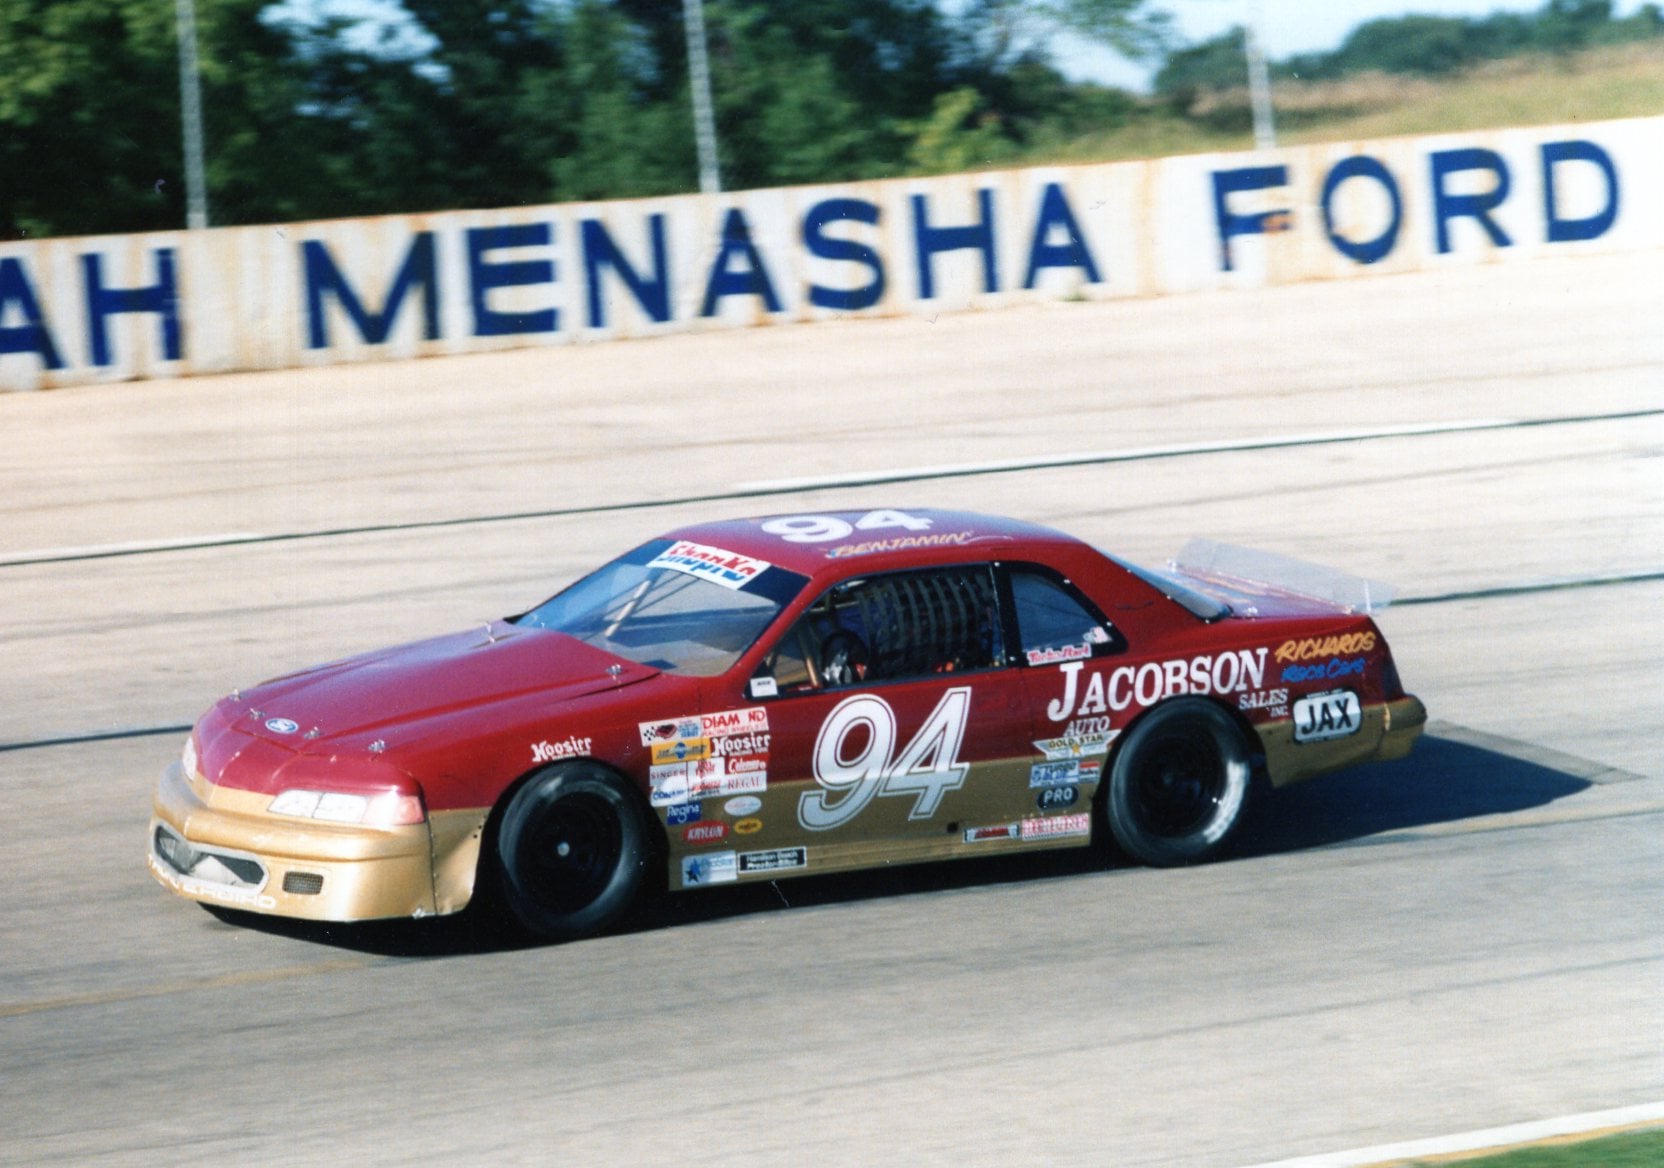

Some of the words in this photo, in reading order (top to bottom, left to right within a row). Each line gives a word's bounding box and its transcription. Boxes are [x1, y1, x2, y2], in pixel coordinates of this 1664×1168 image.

[301, 182, 1103, 349] MENASHA
[1209, 140, 1620, 272] FORD
[761, 509, 933, 543] 94
[831, 531, 967, 557] BENJAMIN
[1275, 631, 1376, 663] RICHARDS
[1047, 648, 1268, 721] JACOBSON
[703, 711, 766, 729] DIAMND
[1063, 716, 1110, 738] AUTO
[1239, 688, 1288, 711] SALES
[1301, 698, 1352, 735] JAX
[531, 735, 592, 762] Hoosier
[711, 731, 771, 757] Hoosier
[1049, 737, 1076, 749] GOLD
[1079, 733, 1105, 745] STAR
[797, 686, 972, 832] 94
[651, 768, 687, 780] SINGER
[728, 776, 760, 791] REGAL
[1044, 787, 1074, 803] PRO
[667, 804, 700, 824] Regina
[687, 825, 725, 841] KRYLON
